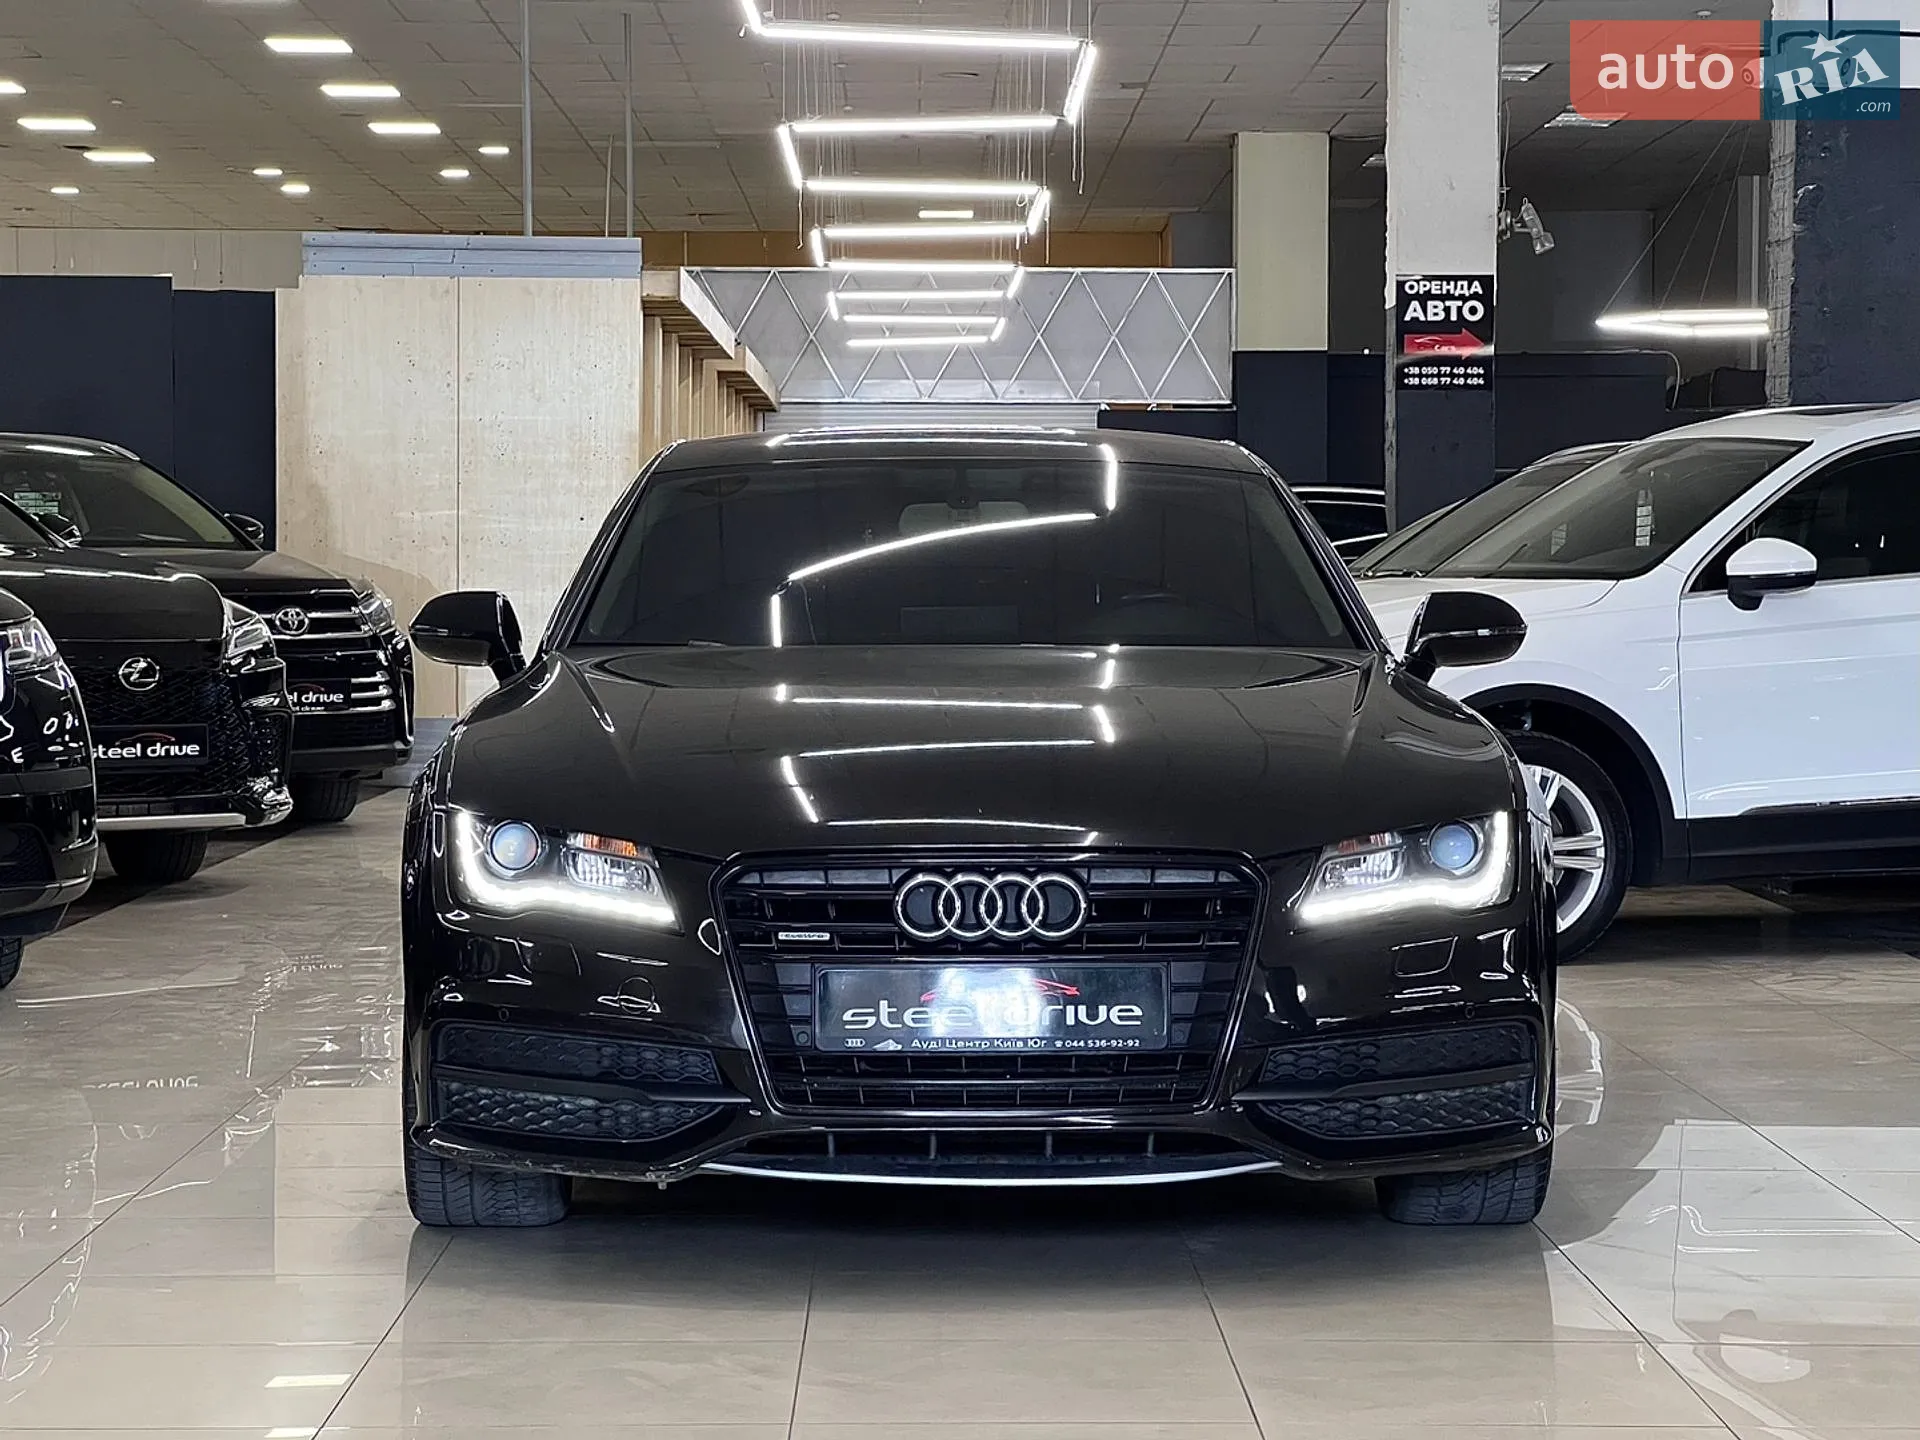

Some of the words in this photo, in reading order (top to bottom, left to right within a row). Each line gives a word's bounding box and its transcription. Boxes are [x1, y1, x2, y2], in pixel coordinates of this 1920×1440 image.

[1404, 280, 1483, 297] ОРЕНДА
[1404, 300, 1484, 322] АВТО
[1403, 366, 1420, 375] +38
[1439, 366, 1452, 375] 77
[1452, 366, 1465, 375] 40
[1466, 366, 1485, 375] 404
[1403, 377, 1420, 385] +38
[1439, 377, 1452, 385] 77
[1452, 377, 1465, 385] 40
[1466, 377, 1485, 385] 404
[301, 691, 344, 703] drive
[146, 742, 200, 757] drive
[911, 1039, 942, 1049] Ауді
[945, 1039, 990, 1049] Центр
[994, 1039, 1024, 1048] Київ
[1027, 1039, 1047, 1048] Юг
[1065, 1039, 1085, 1048] 044
[1087, 1039, 1140, 1048] 536-92-92
